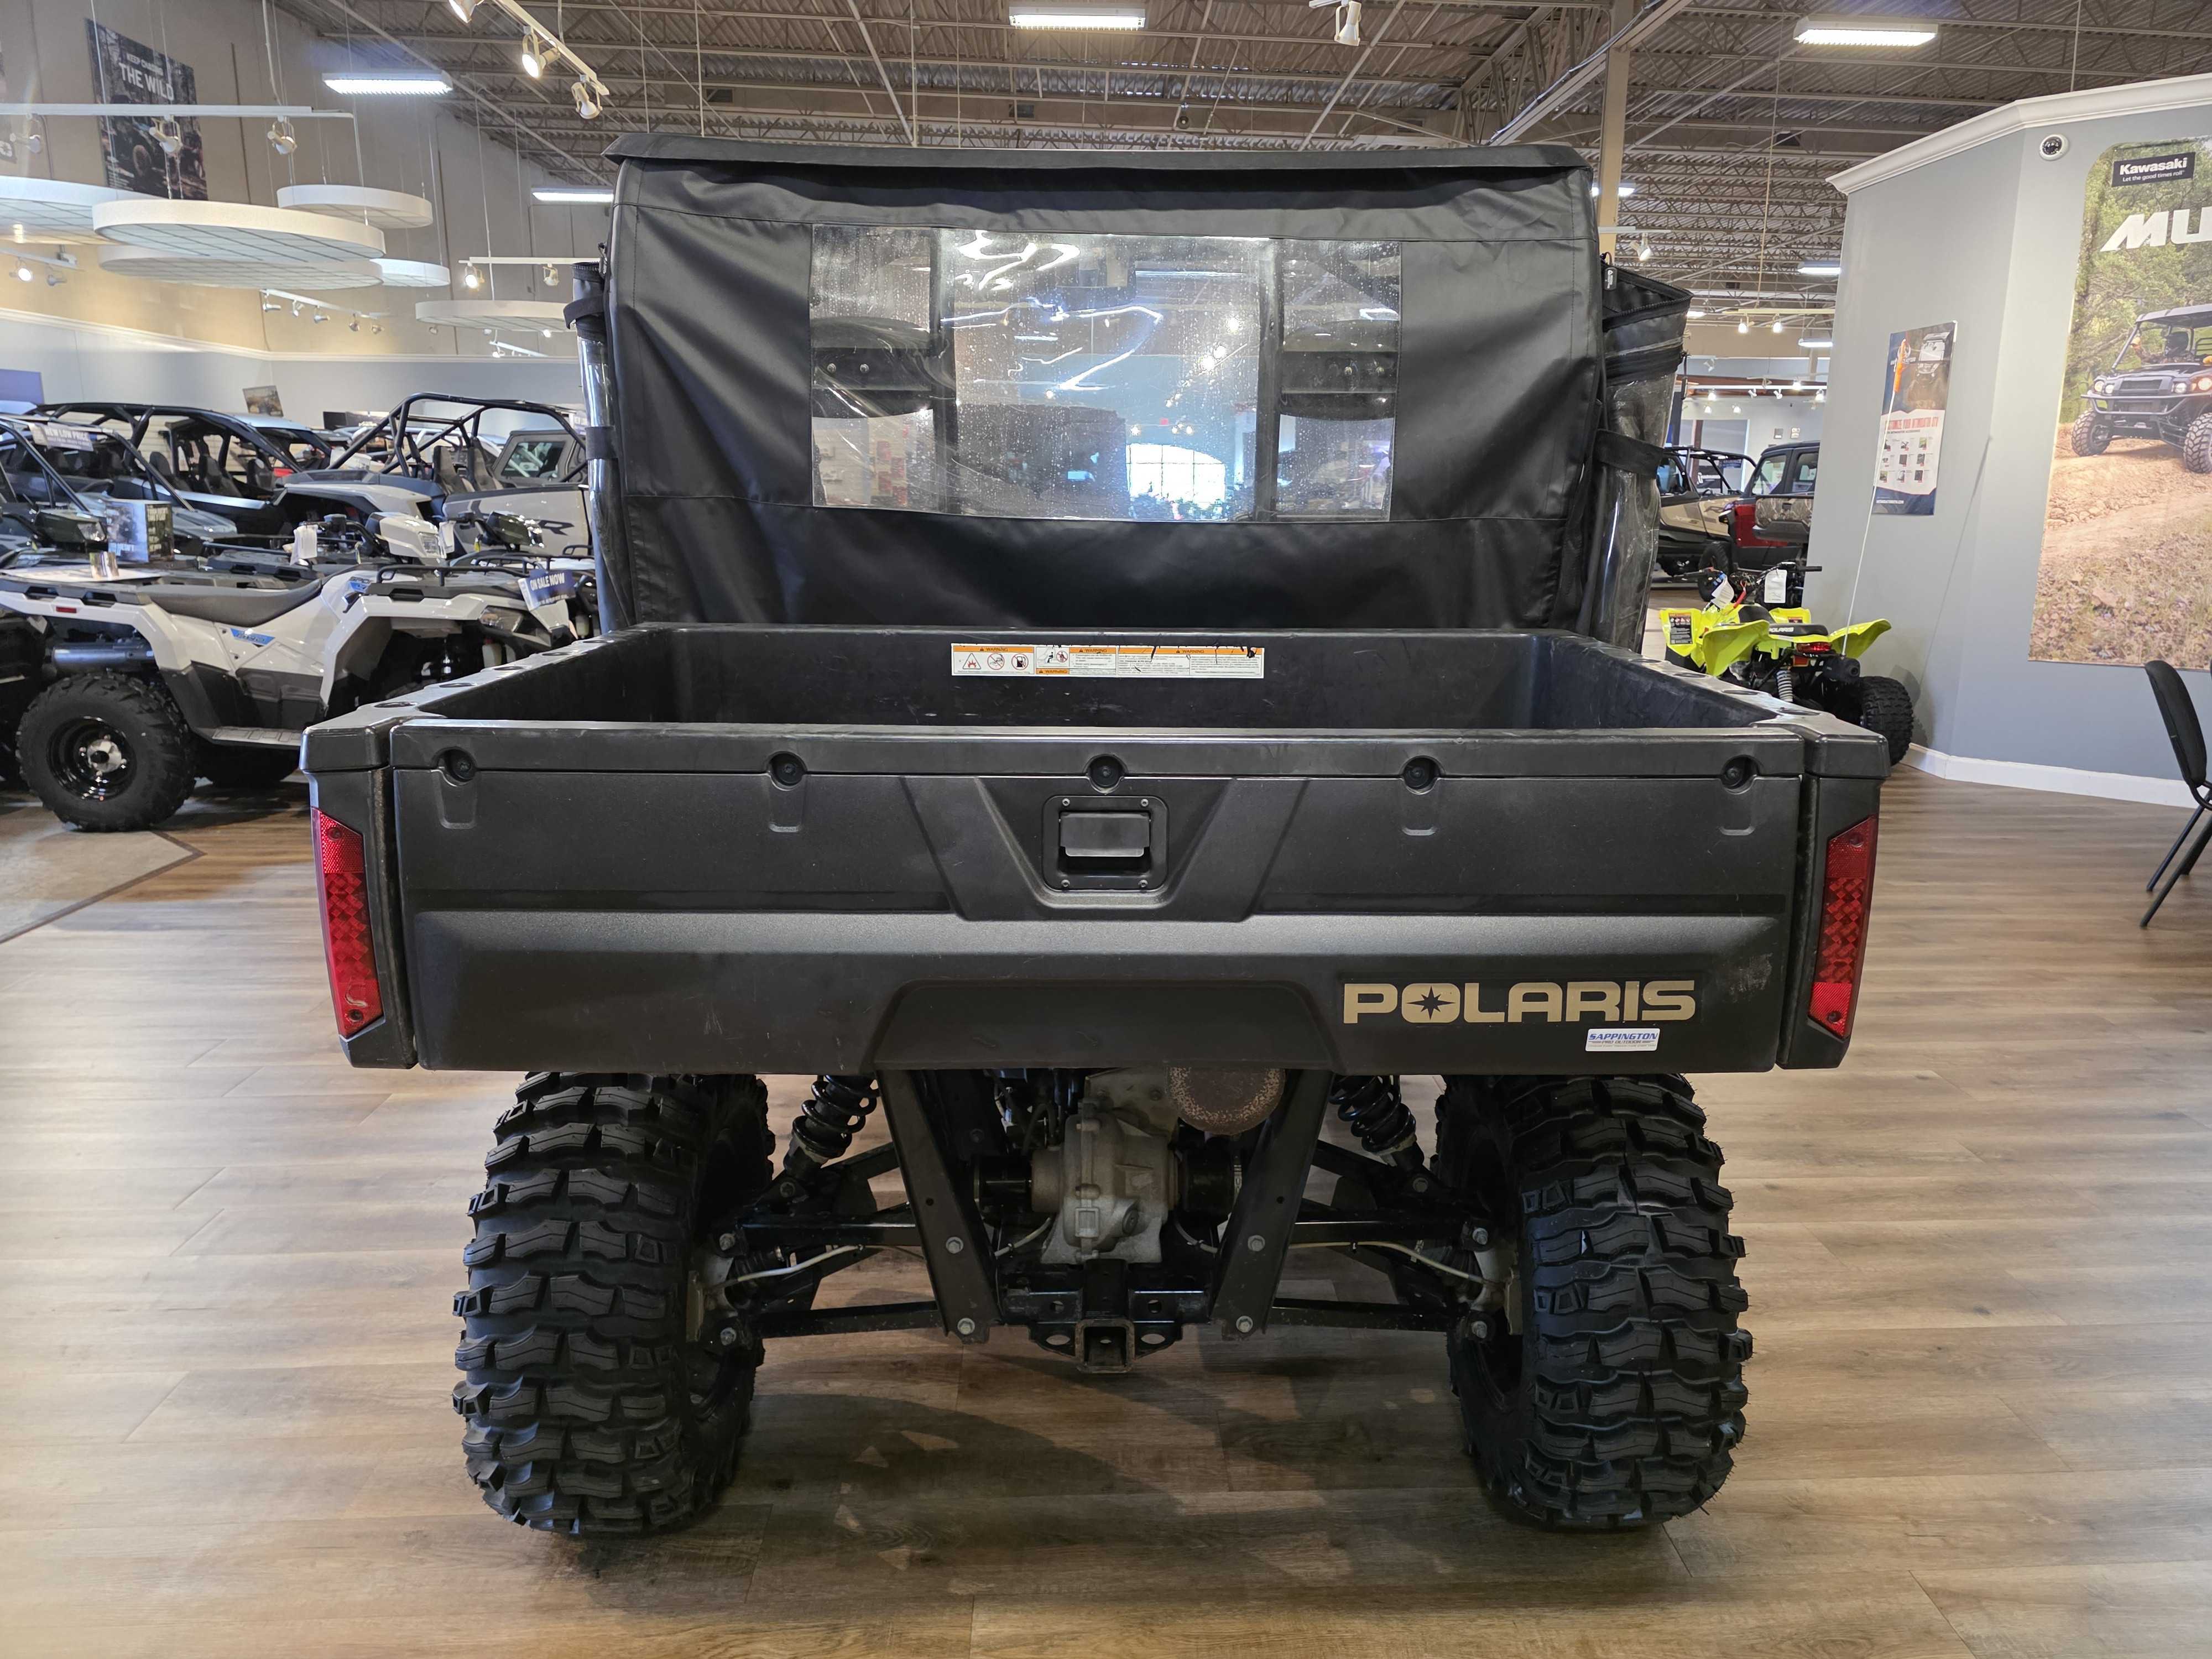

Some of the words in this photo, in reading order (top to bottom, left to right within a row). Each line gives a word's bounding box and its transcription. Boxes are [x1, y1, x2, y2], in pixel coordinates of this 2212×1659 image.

[118, 62, 144, 88] THE
[144, 73, 174, 101] WILD
[2120, 157, 2188, 175] Kawasaki
[530, 580, 538, 591] ON
[537, 576, 550, 589] SALE
[549, 572, 565, 586] NOW
[1343, 980, 1696, 1024] POLARIS
